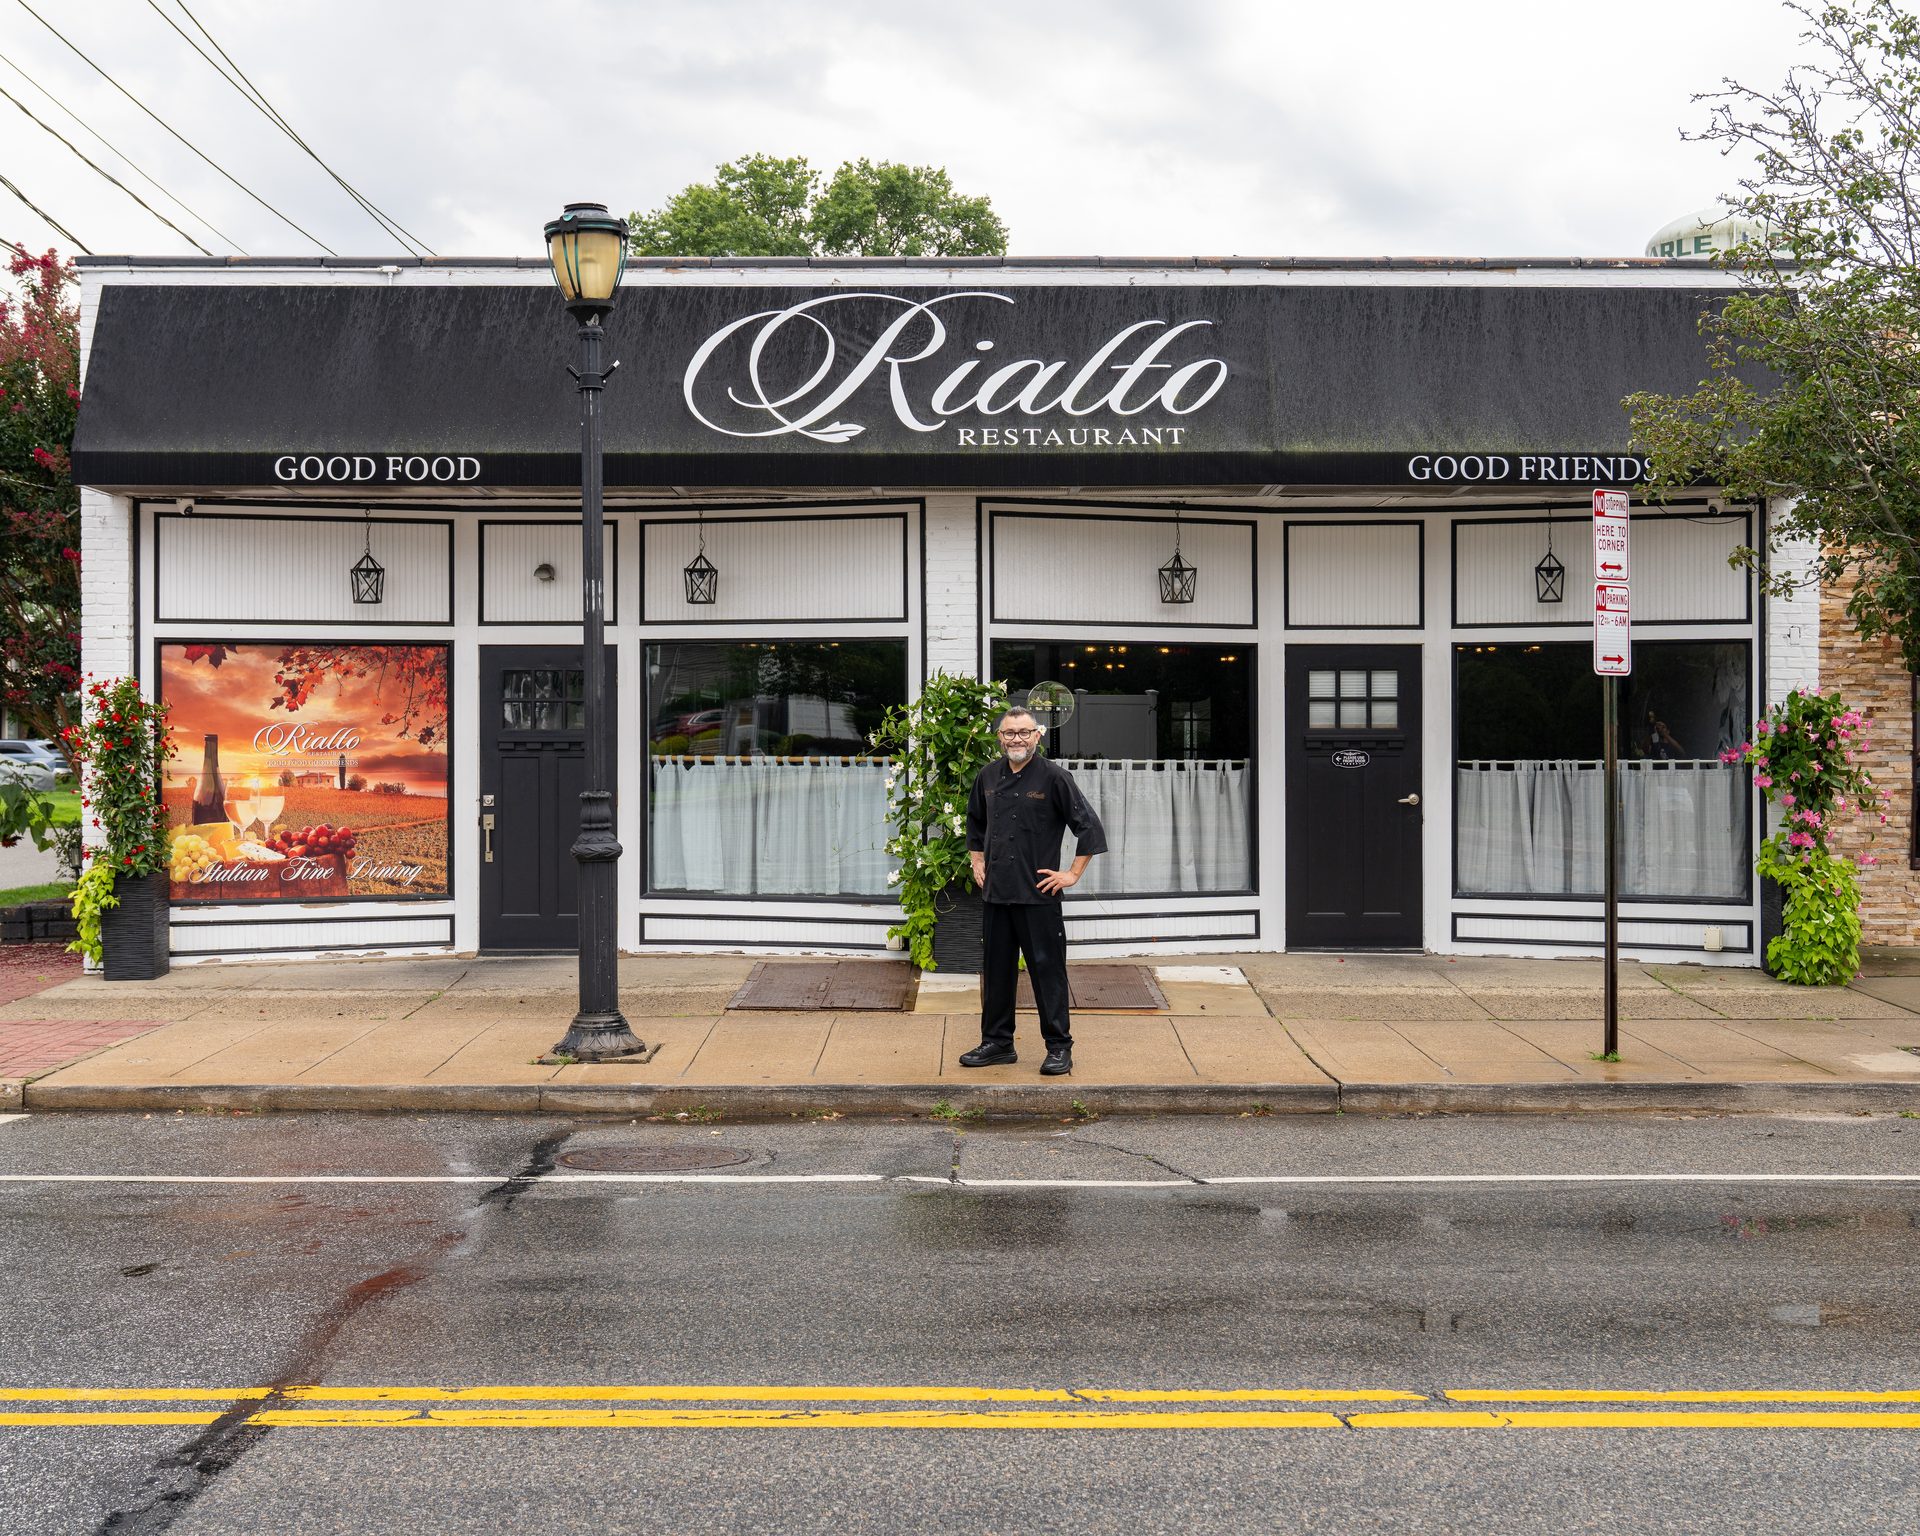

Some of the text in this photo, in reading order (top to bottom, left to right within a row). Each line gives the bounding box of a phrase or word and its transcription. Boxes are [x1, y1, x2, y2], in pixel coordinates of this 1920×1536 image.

[683, 292, 1228, 443] Rialto
[958, 428, 1185, 446] RESTAURANT
[274, 456, 481, 481] GOOD FOOD
[1408, 455, 1510, 480] GOOD
[1596, 495, 1626, 512] NO STOPPING
[1597, 525, 1626, 538] HERE TO
[1598, 539, 1625, 551] CORNER
[1596, 590, 1628, 607] NO PARKING
[188, 855, 423, 886] Italian Fine Dining
